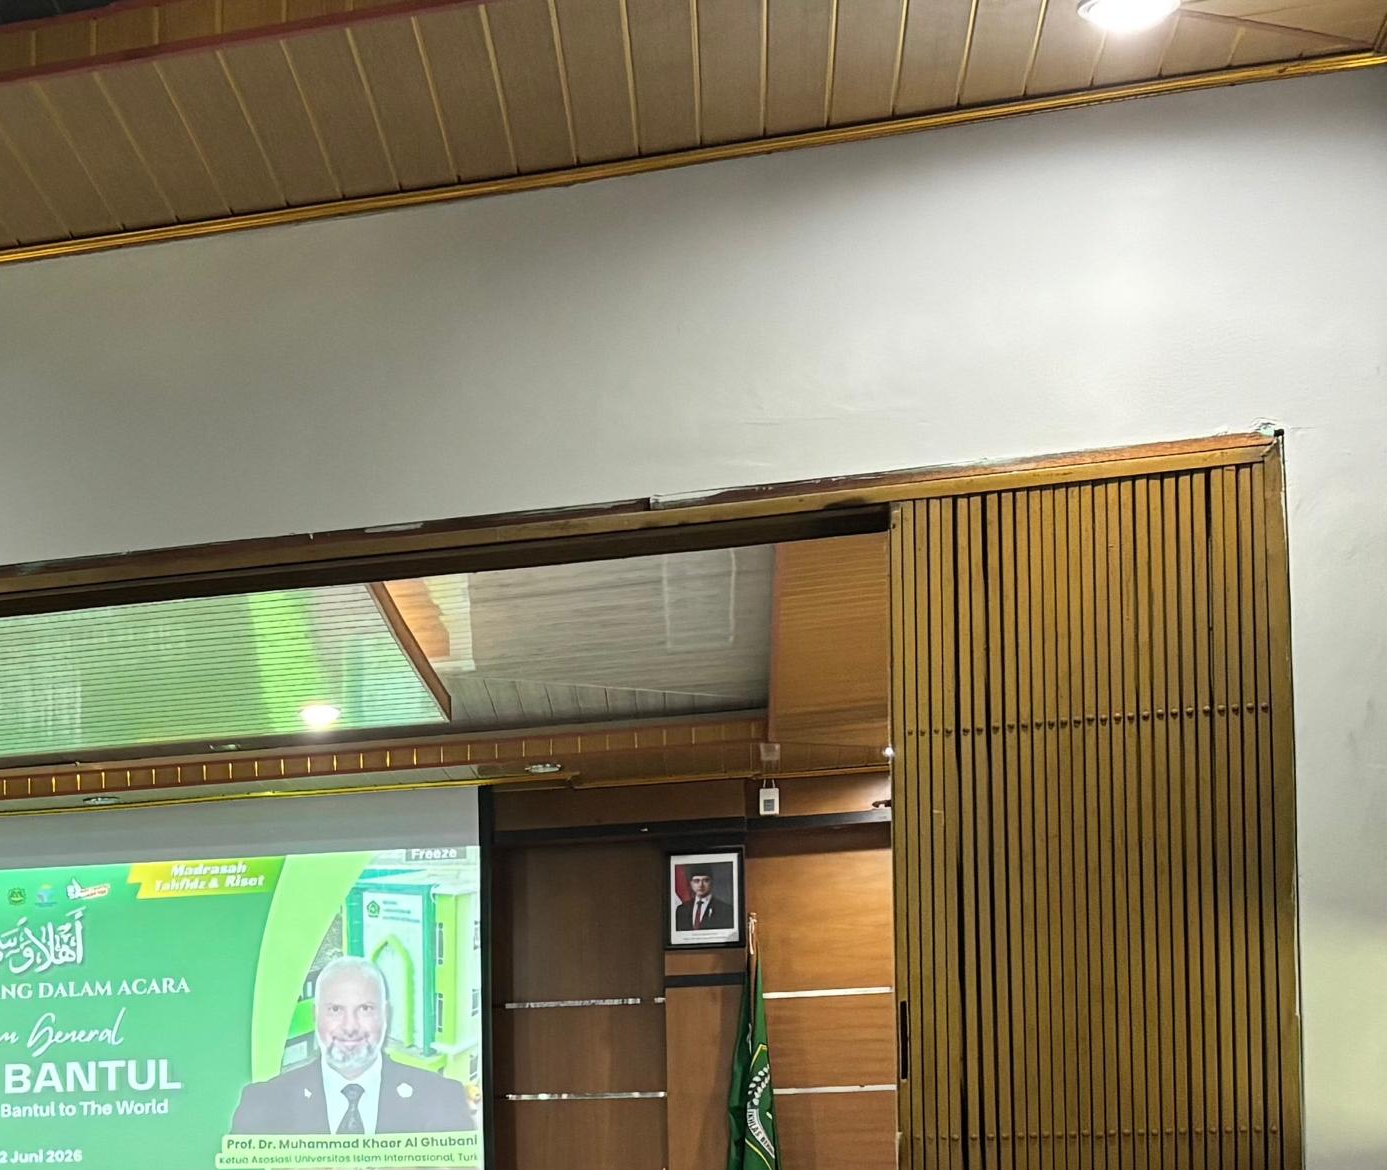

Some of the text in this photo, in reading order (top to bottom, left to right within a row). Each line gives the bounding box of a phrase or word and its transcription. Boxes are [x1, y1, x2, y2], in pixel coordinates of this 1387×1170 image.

[411, 848, 458, 860] Freeze
[171, 862, 247, 877] Madrasah
[38, 981, 113, 999] DALAM
[116, 977, 191, 997] ACARA
[26, 1007, 127, 1058] General
[4, 1058, 183, 1096] BANTUL
[0, 1101, 56, 1119] Bantul
[58, 1102, 77, 1118] to
[79, 1100, 113, 1117] The
[116, 1098, 170, 1116] World
[226, 1138, 256, 1150] Prof.
[258, 1139, 277, 1150] Dr.
[279, 1138, 360, 1150] Muhammad
[405, 1137, 418, 1148] Al
[421, 1134, 478, 1148] Ghubani
[10, 1149, 44, 1165] Juni
[46, 1149, 84, 1164] 2026
